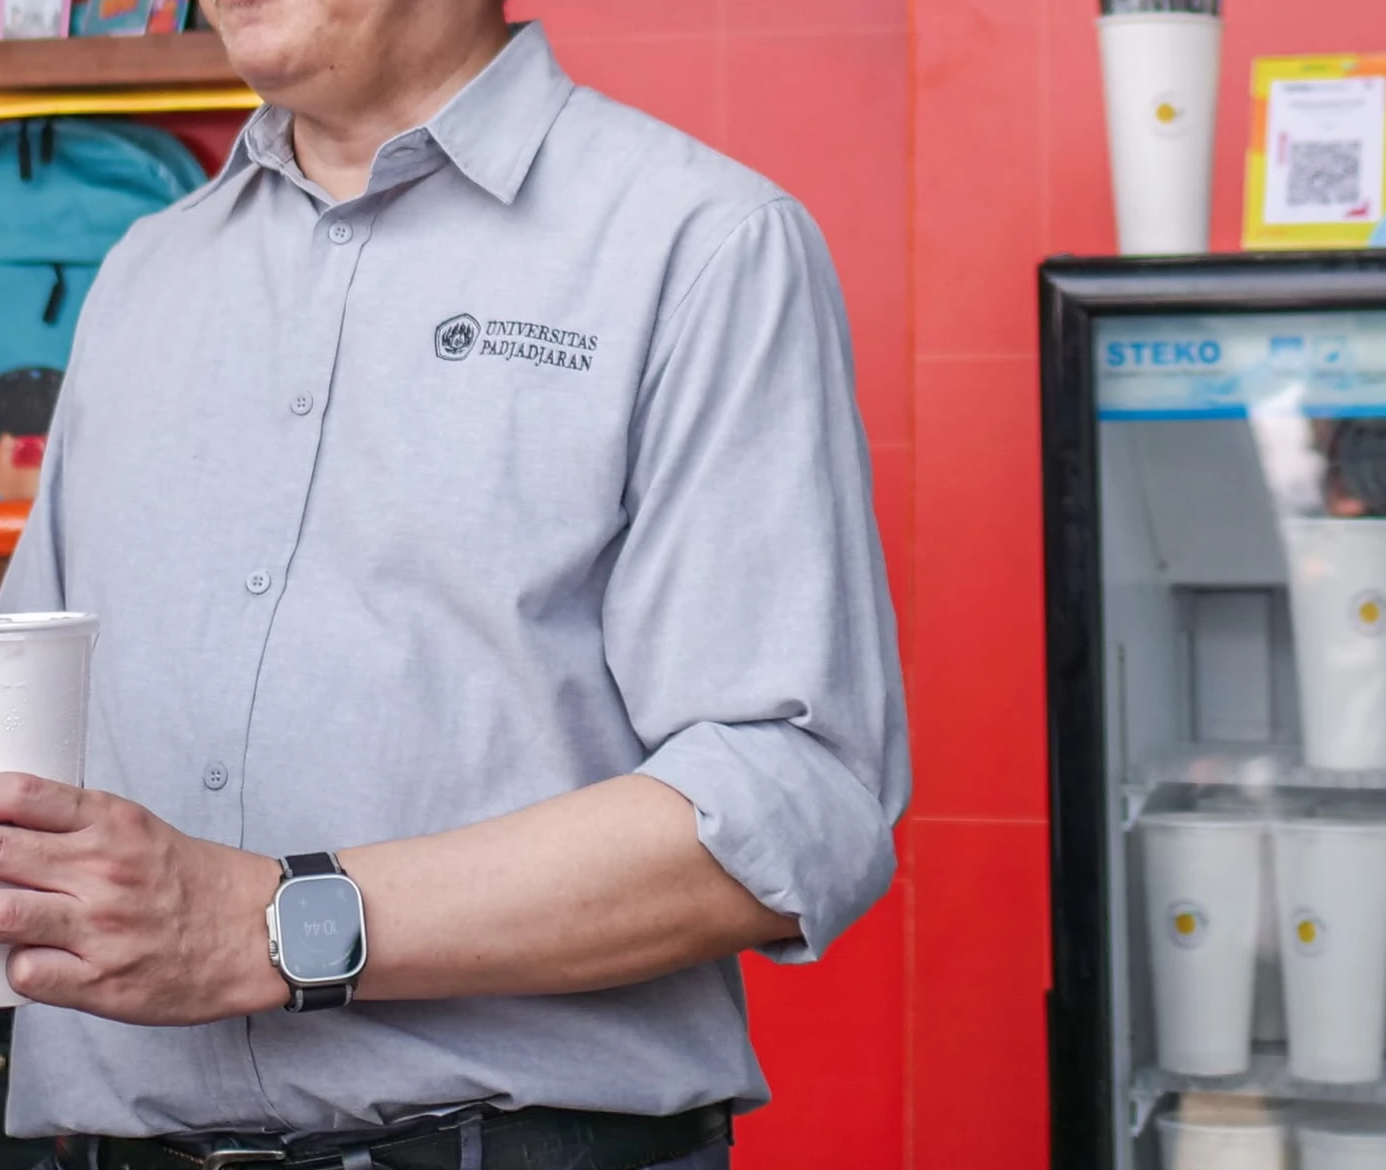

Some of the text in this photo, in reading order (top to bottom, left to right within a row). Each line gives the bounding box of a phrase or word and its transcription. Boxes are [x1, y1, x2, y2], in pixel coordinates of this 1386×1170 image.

[485, 320, 598, 352] UNIVERSITAS
[480, 339, 593, 371] PADJADJARAN
[1105, 338, 1222, 367] STEKO
